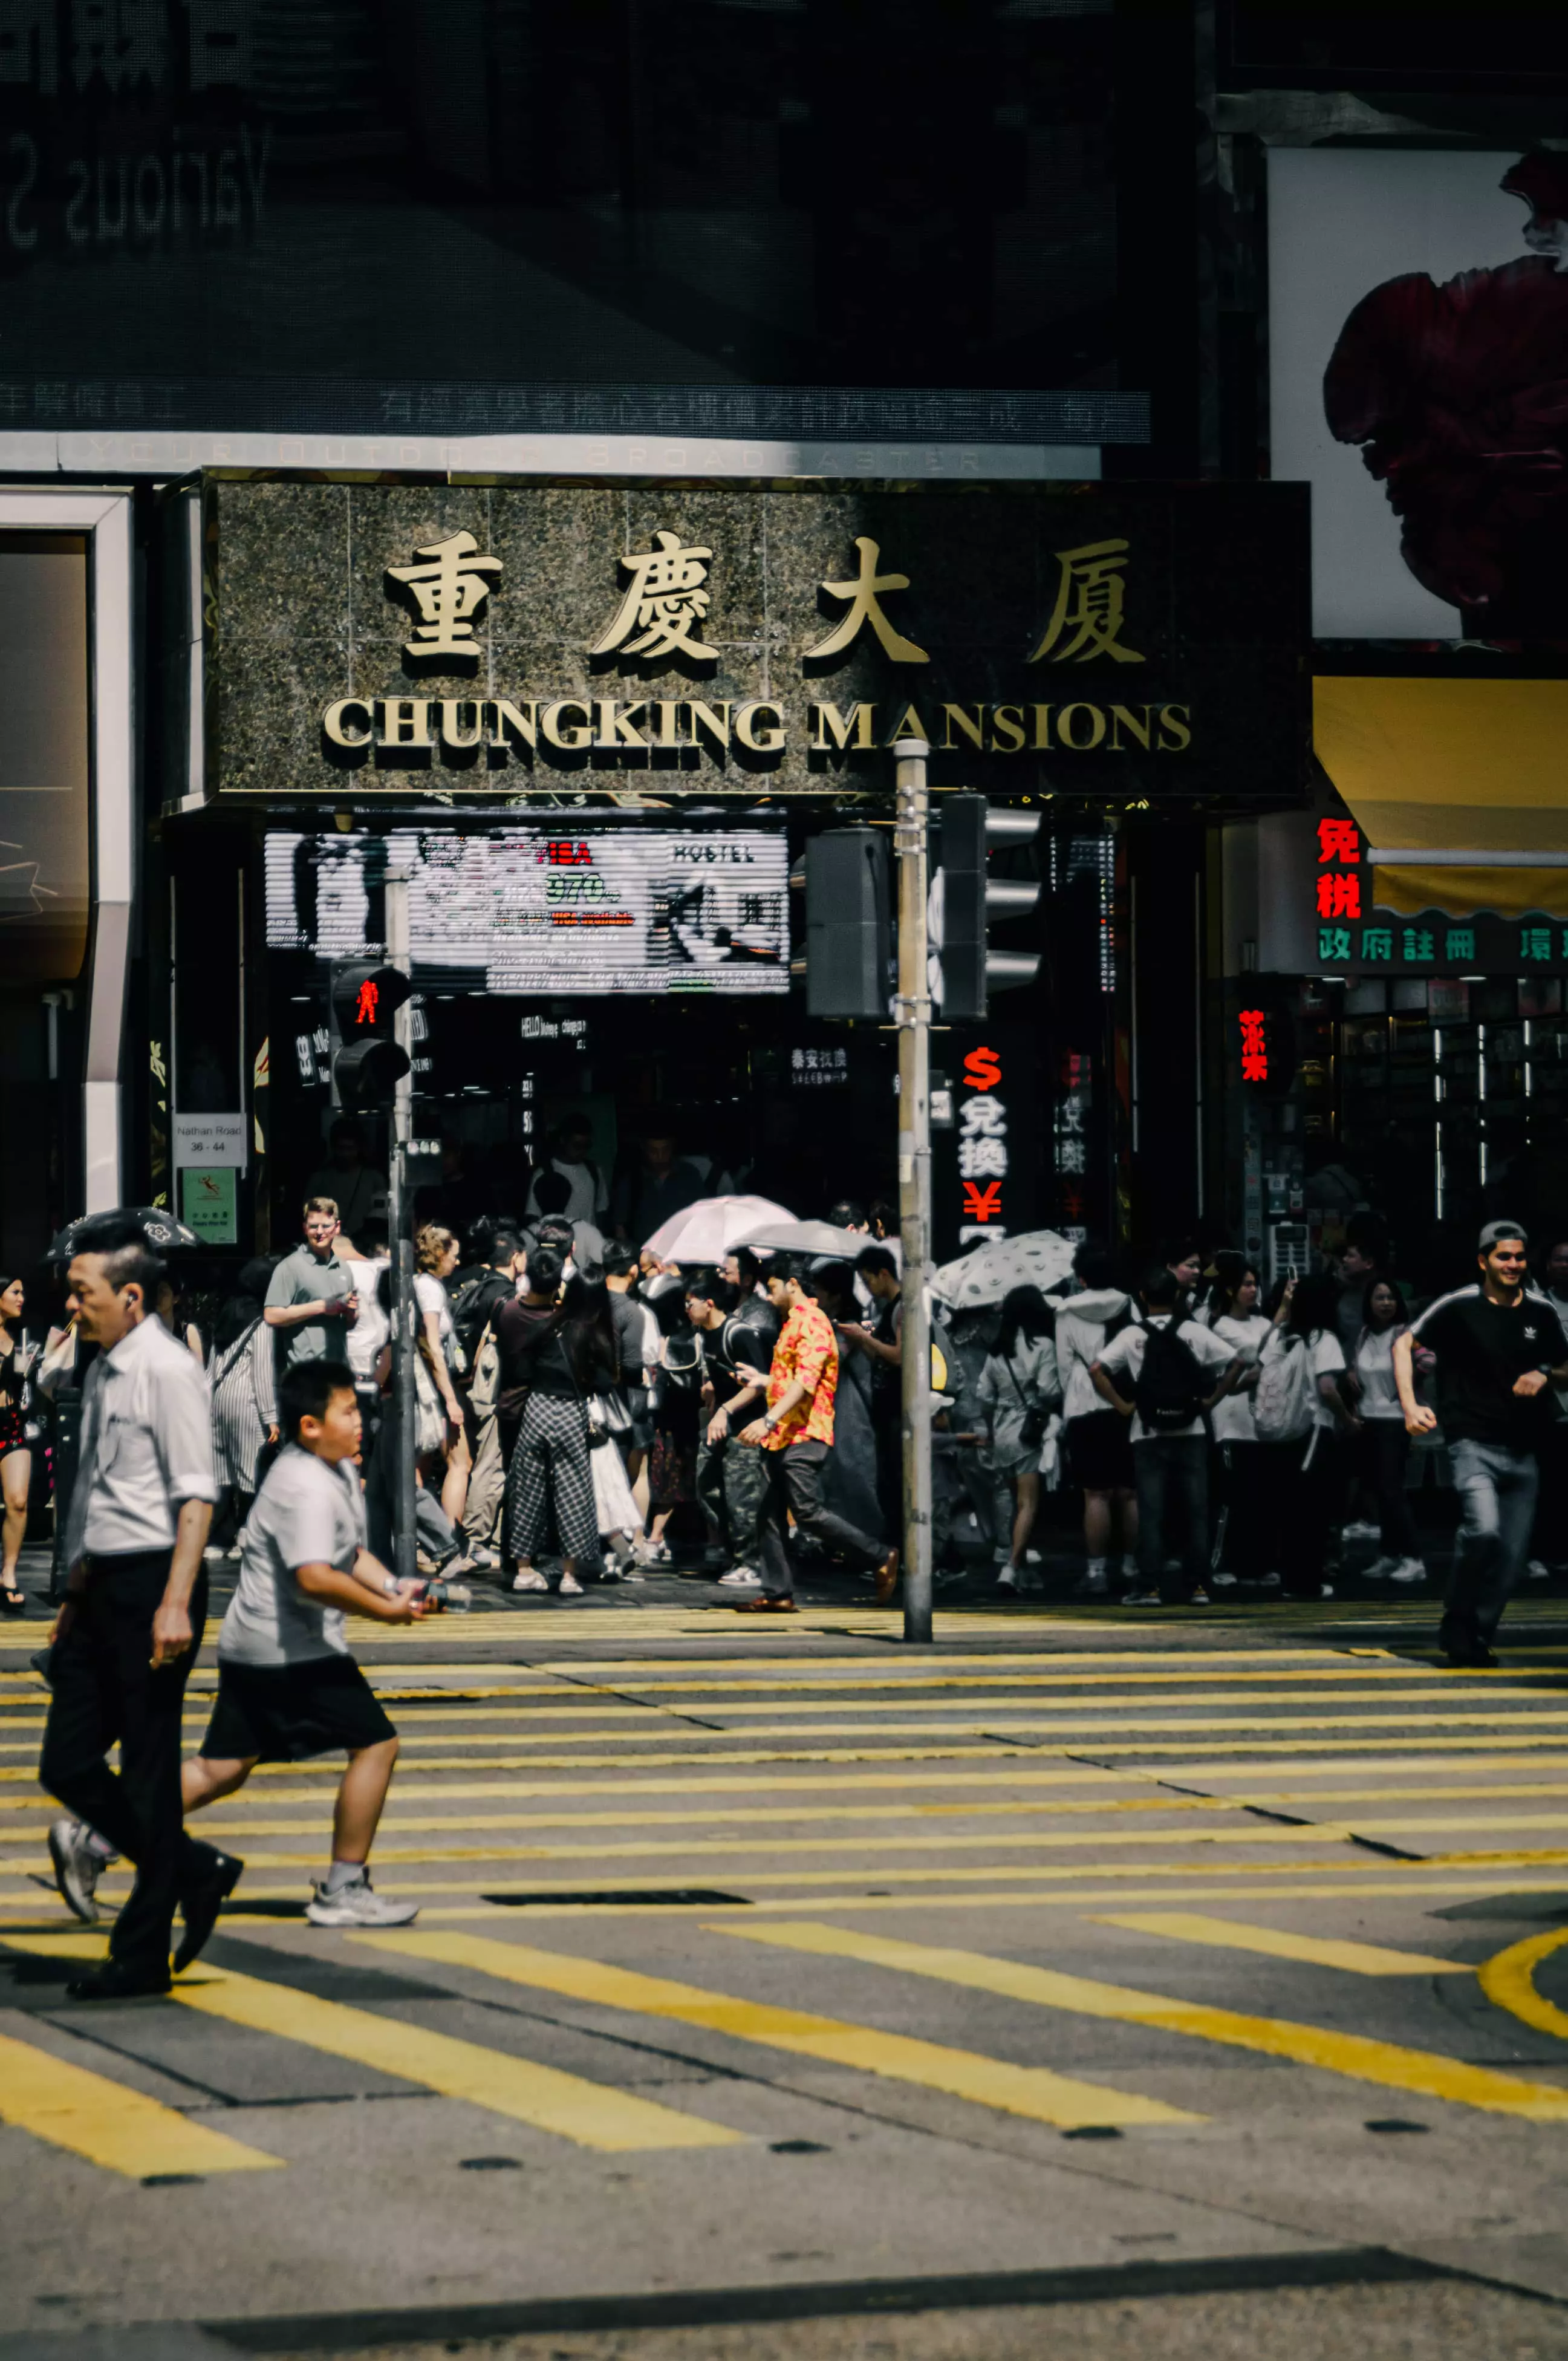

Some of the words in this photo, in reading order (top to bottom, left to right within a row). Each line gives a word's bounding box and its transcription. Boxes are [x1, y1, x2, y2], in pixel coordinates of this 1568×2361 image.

[324, 697, 789, 752] CHUNGKING
[812, 702, 1191, 752] MANSIONS
[672, 843, 755, 863] HOSTEL
[1319, 928, 1475, 960] 政府註冊
[1520, 928, 1568, 961] 環
[177, 1125, 213, 1135] Nathan
[213, 1142, 225, 1151] 44
